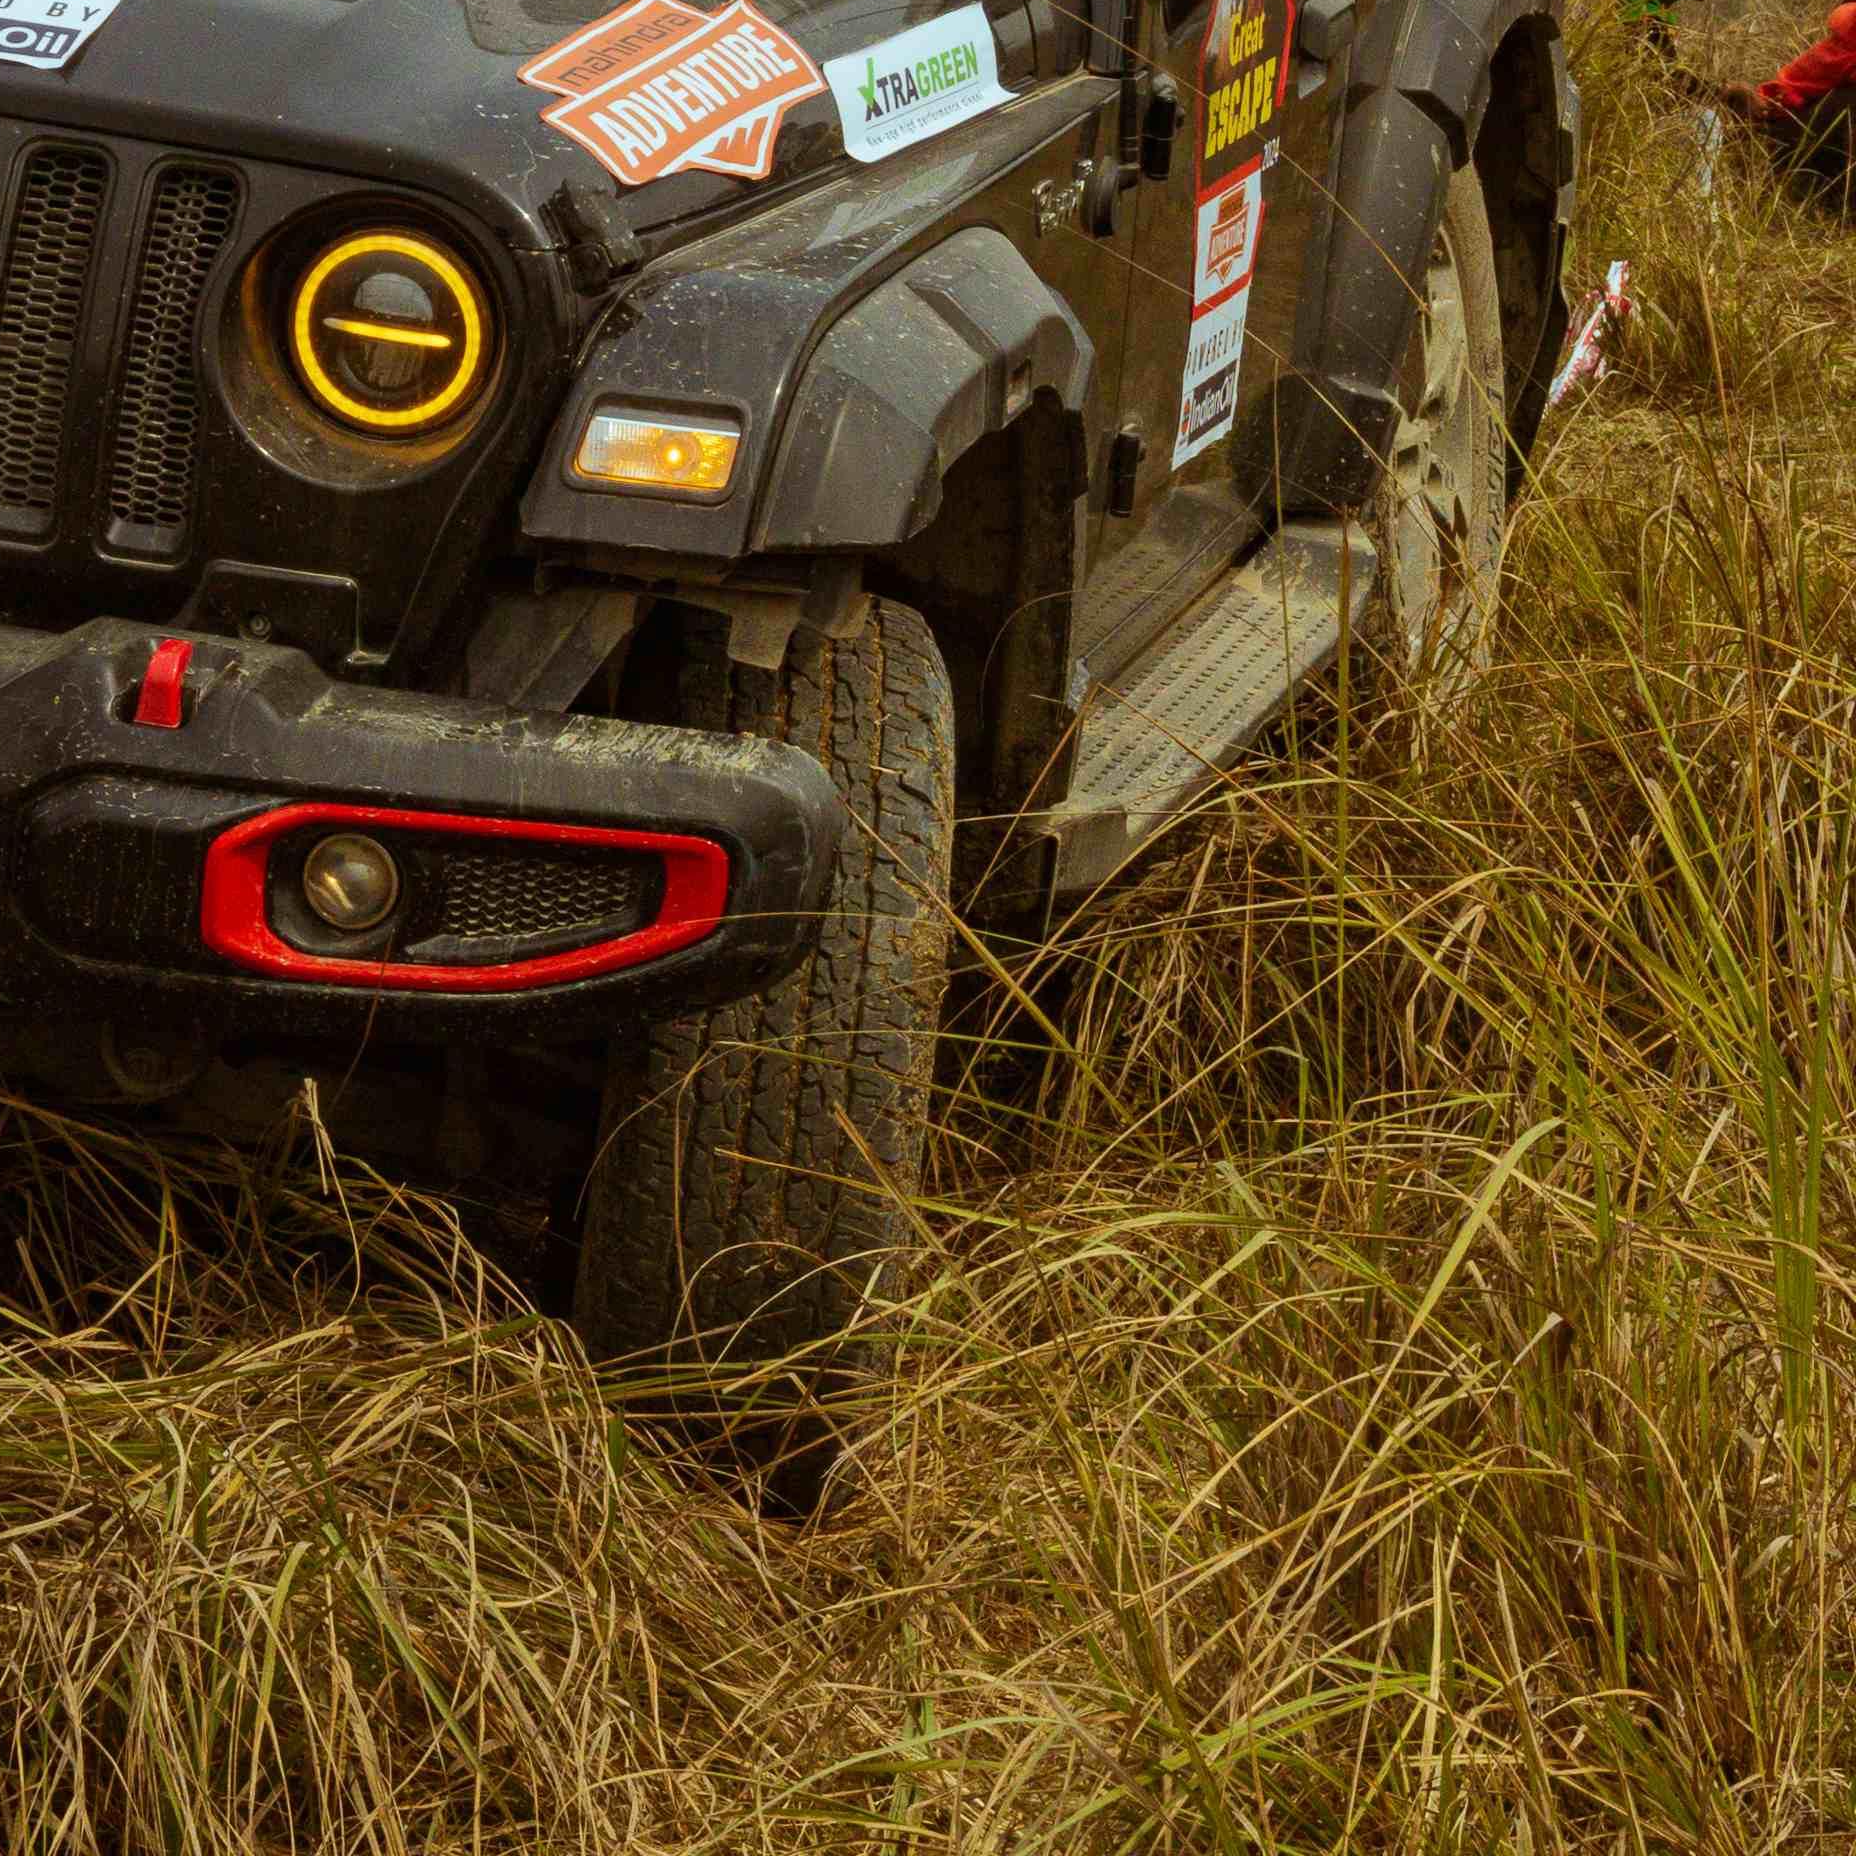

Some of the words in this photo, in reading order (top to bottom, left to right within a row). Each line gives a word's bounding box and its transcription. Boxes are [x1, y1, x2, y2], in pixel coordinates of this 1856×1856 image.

[45, 1, 101, 23] BY
[557, 12, 692, 89] mahindra
[1229, 10, 1265, 67] Great
[587, 21, 800, 169] ADVENTURE
[857, 40, 979, 122] XTRAGREEN
[1204, 56, 1277, 161] ESCAPE
